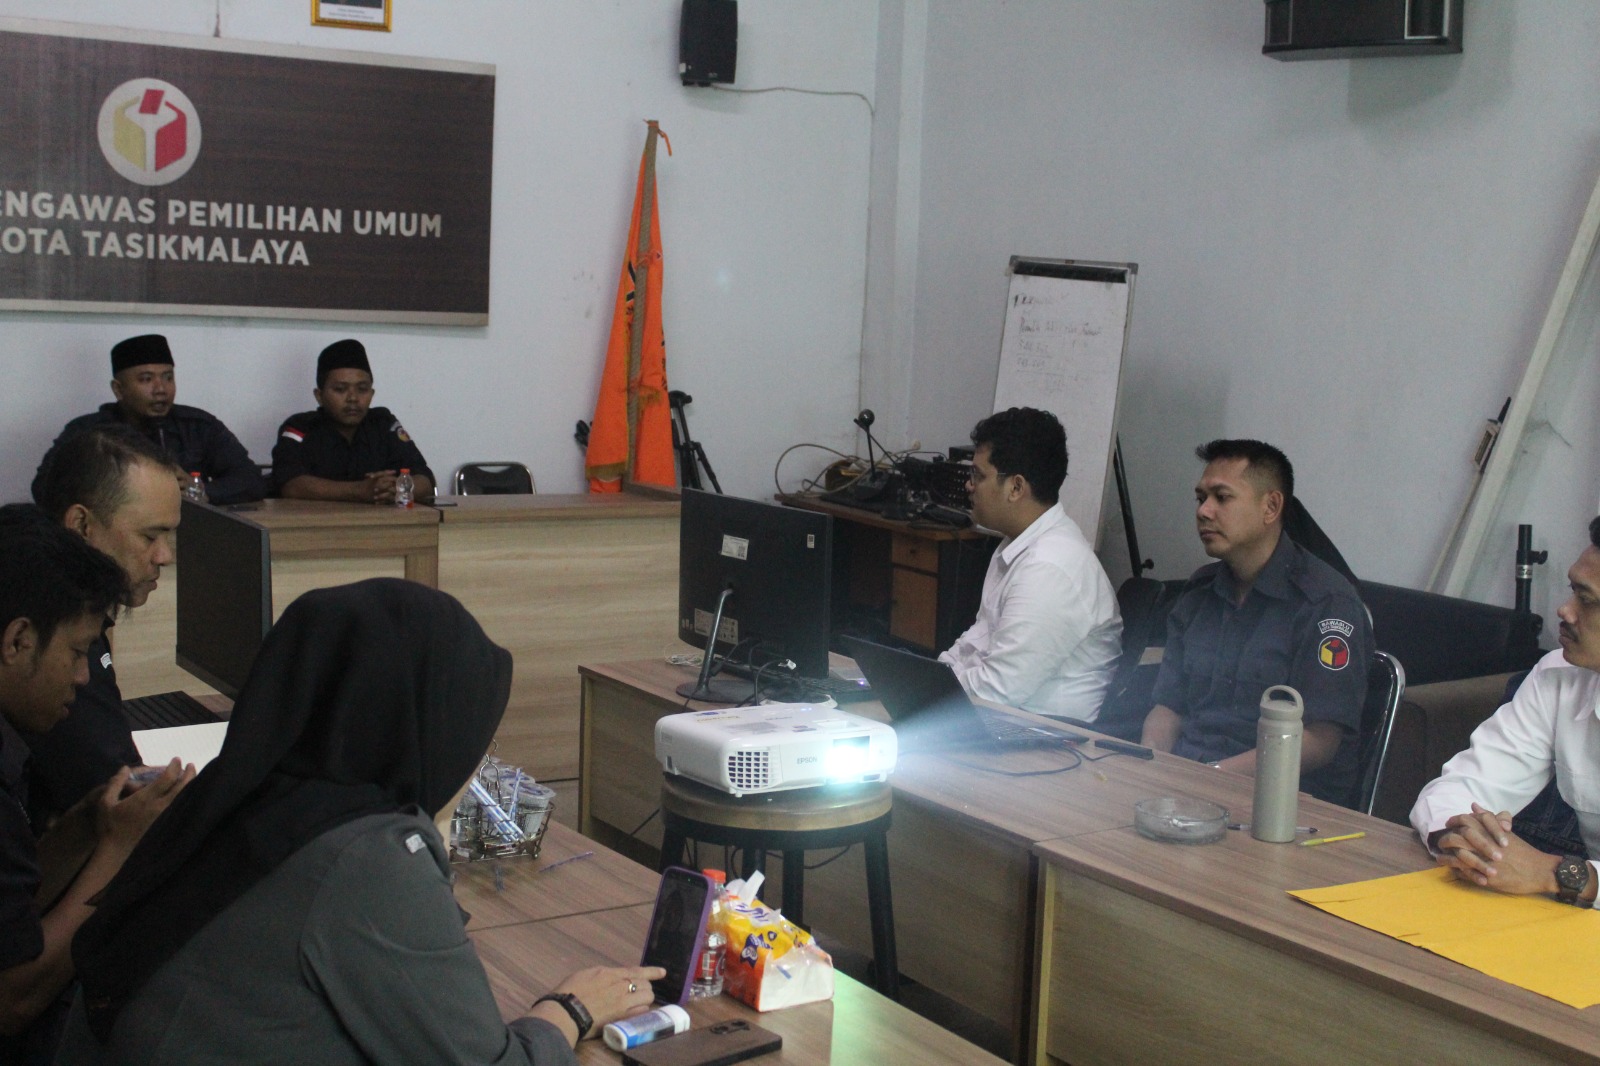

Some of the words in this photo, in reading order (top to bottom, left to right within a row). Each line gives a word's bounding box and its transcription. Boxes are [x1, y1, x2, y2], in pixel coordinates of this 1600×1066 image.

[0, 190, 155, 224] NGAWAS
[168, 200, 342, 235] PEMILIHAN
[353, 211, 442, 238] UMUM
[0, 226, 71, 256] OTA
[82, 230, 310, 267] TASIKMALAYA
[796, 756, 818, 765] EPSON
